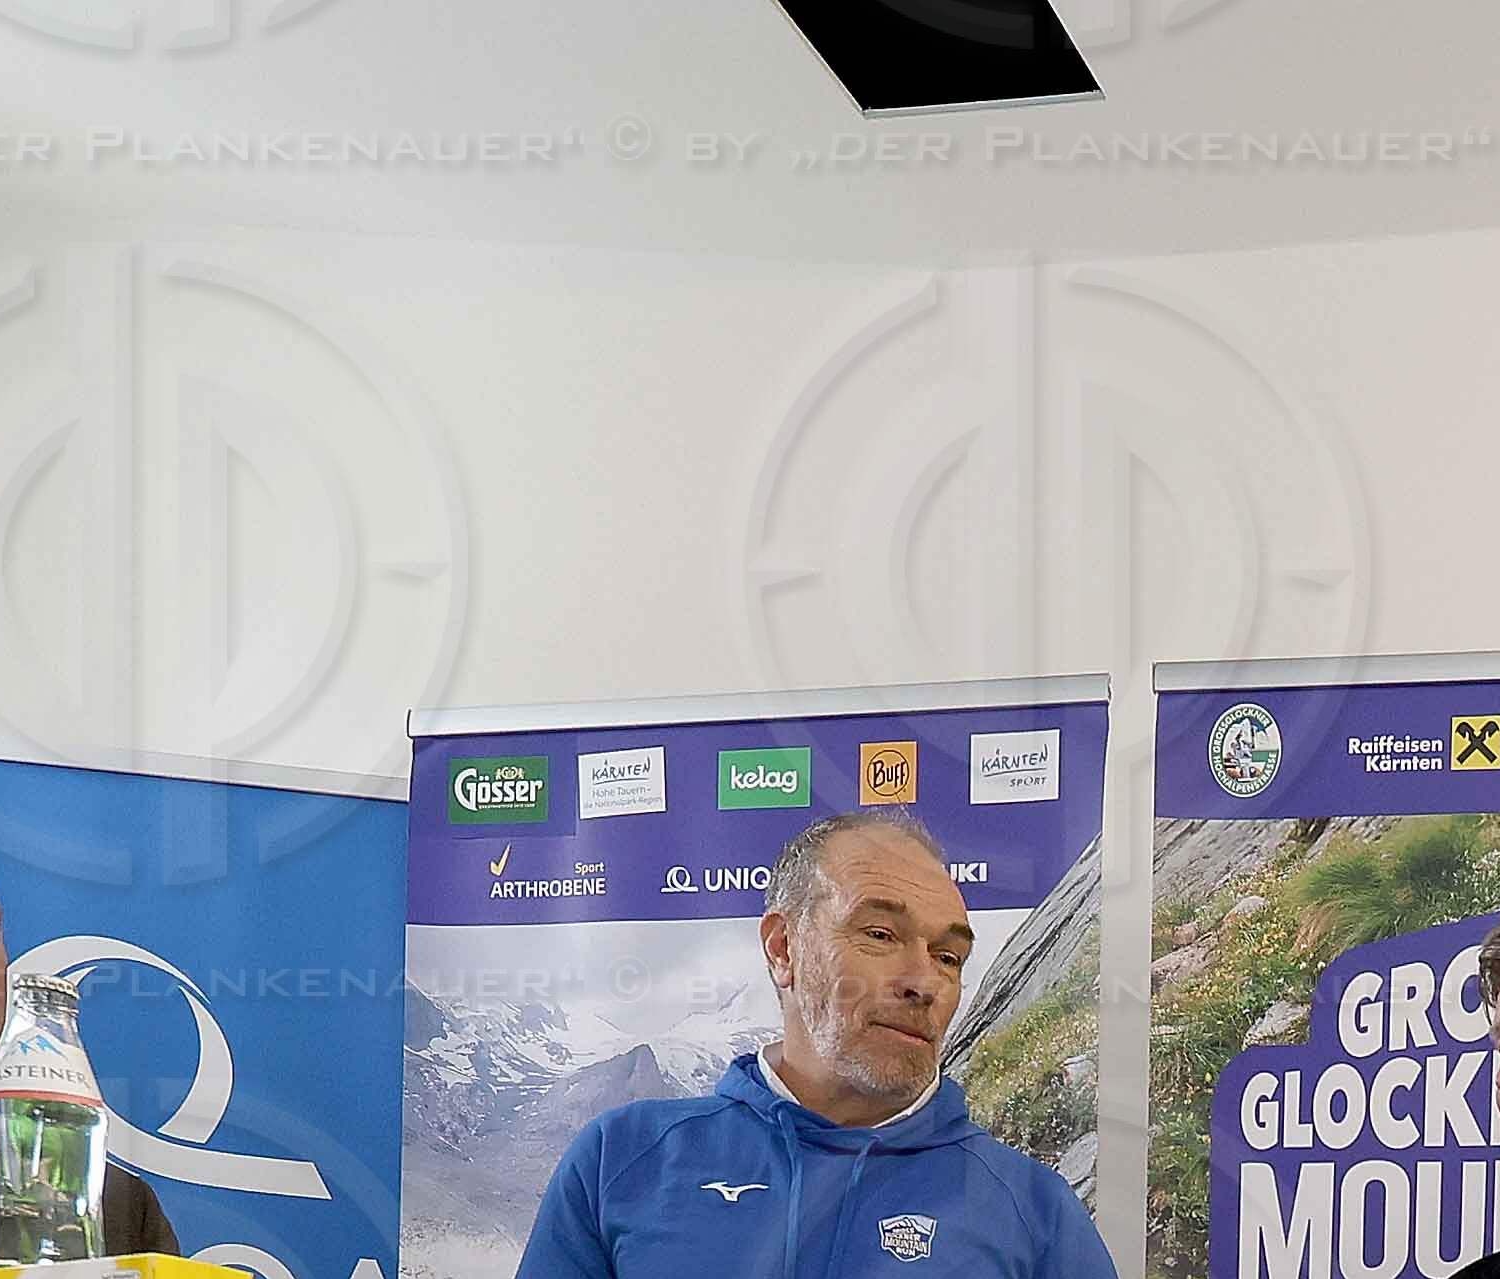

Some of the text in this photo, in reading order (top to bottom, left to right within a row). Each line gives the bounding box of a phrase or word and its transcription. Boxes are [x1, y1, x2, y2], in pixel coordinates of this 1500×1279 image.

[1347, 735, 1444, 755] Raiffeisen
[1365, 753, 1443, 773] Kärnten
[453, 768, 544, 811] Gösser
[731, 765, 798, 793] kelag
[1009, 776, 1047, 788] SPORT
[575, 862, 605, 876] Sport
[704, 867, 772, 892] UNIQ
[490, 878, 606, 899] ARTHROBENE
[1337, 944, 1490, 1059] GRO
